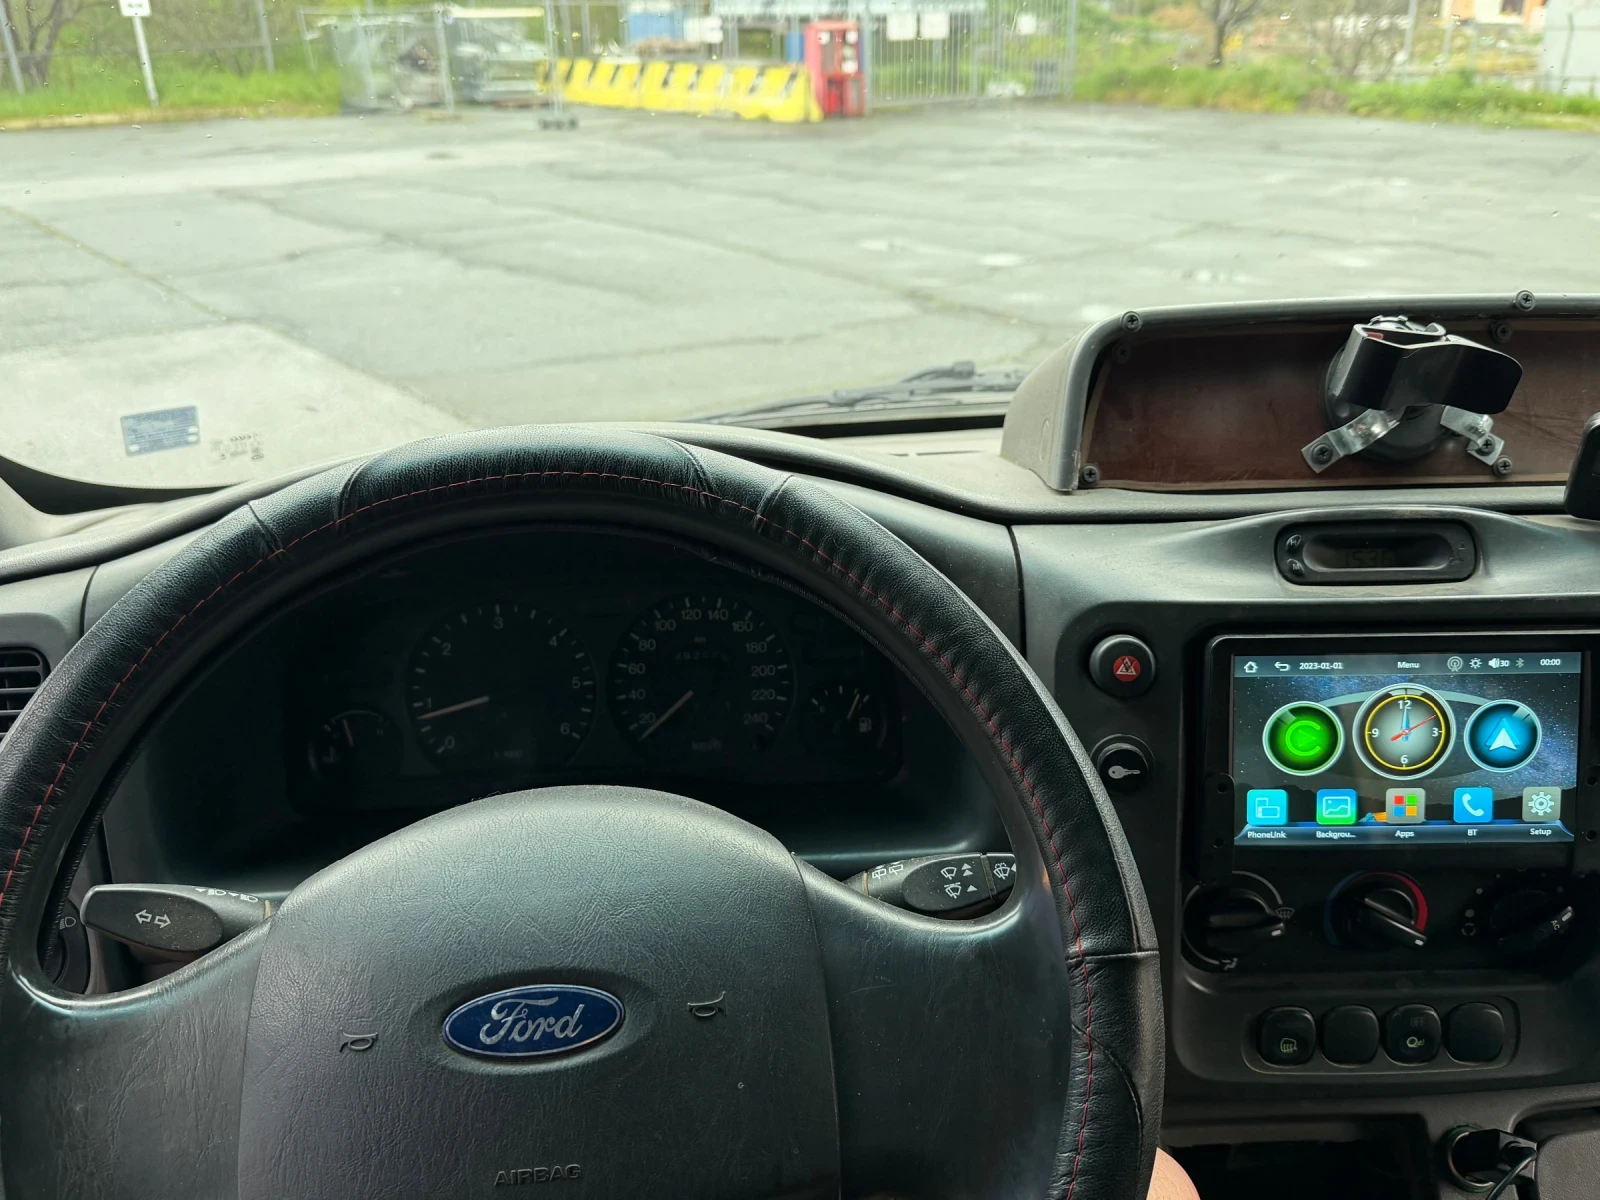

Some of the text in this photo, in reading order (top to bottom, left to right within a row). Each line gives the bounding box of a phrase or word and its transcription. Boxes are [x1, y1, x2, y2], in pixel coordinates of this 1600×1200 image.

[681, 609, 702, 621] 120
[708, 609, 729, 621] 140
[493, 617, 504, 630] 3
[655, 619, 676, 632] 100
[732, 621, 753, 633] 160
[548, 636, 558, 647] 4
[638, 639, 656, 652] 80
[745, 641, 767, 654] 180
[441, 643, 452, 657] 2
[628, 662, 646, 675] 60
[751, 665, 776, 677] 200
[1299, 662, 1344, 670] 2023-01-01
[1397, 661, 1419, 669] Menu
[571, 677, 581, 689] 5
[628, 688, 646, 700] 40
[751, 689, 776, 701] 220
[1398, 700, 1412, 710] 12
[639, 712, 656, 724] 20
[743, 712, 769, 725] 240
[560, 722, 571, 735] 6
[1372, 728, 1379, 738] 9
[1432, 728, 1439, 737] 3
[444, 736, 455, 749] 0
[1401, 755, 1409, 764] 6
[1247, 831, 1287, 839] PhoneLink
[1395, 830, 1415, 840] Apps
[1529, 828, 1552, 837] Setup
[480, 995, 585, 1045] Ford
[493, 1163, 581, 1187] AIRBAG
